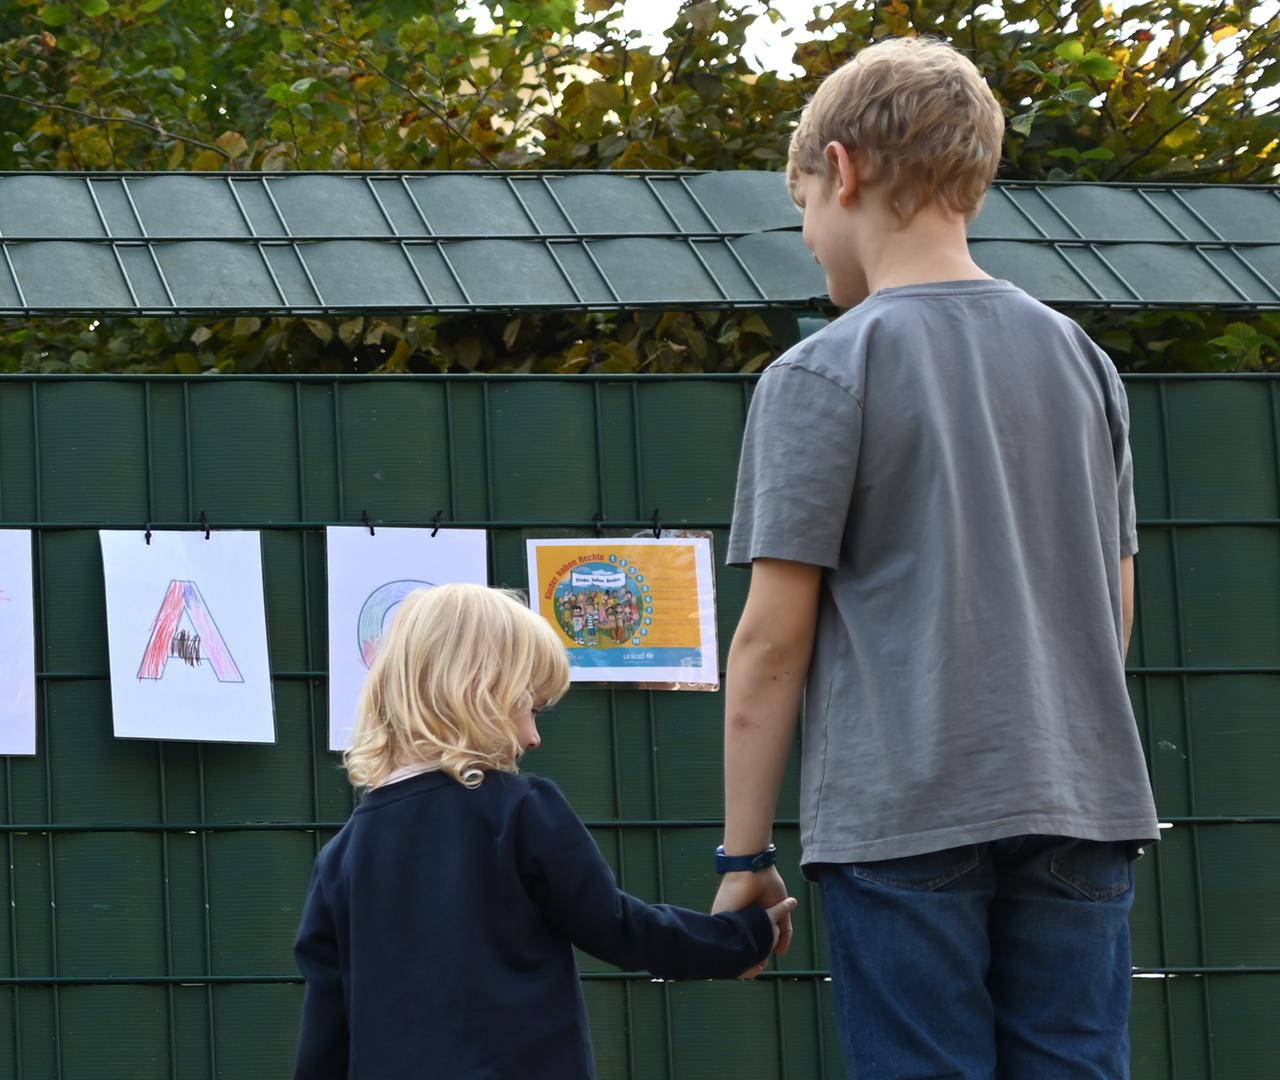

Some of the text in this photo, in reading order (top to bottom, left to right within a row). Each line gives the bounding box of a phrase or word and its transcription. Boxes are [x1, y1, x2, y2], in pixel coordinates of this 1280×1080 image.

[544, 554, 605, 600] Kinder haben Rechte
[623, 652, 645, 660] unicef
